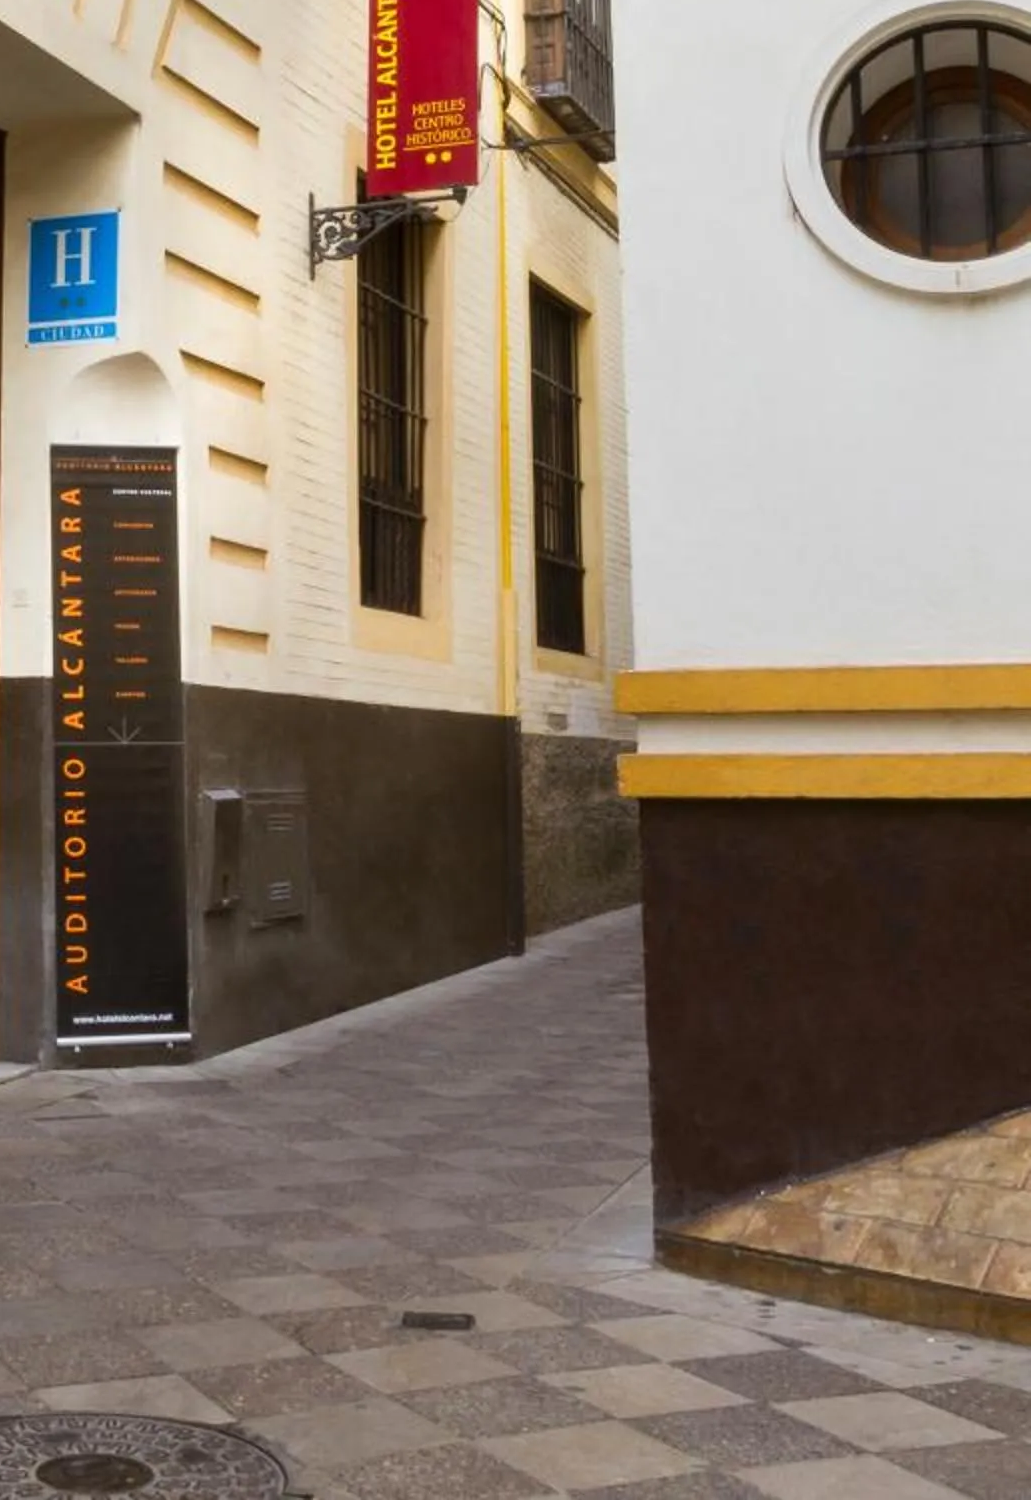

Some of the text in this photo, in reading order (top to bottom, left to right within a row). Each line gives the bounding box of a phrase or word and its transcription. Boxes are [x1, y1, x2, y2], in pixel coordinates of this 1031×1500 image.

[412, 97, 466, 115] HOTELES
[414, 113, 464, 131] CENTRO
[376, 92, 398, 169] HOTEL
[50, 227, 97, 288] H
[40, 325, 104, 341] CIUDAD
[61, 758, 89, 995] AUDITORIO
